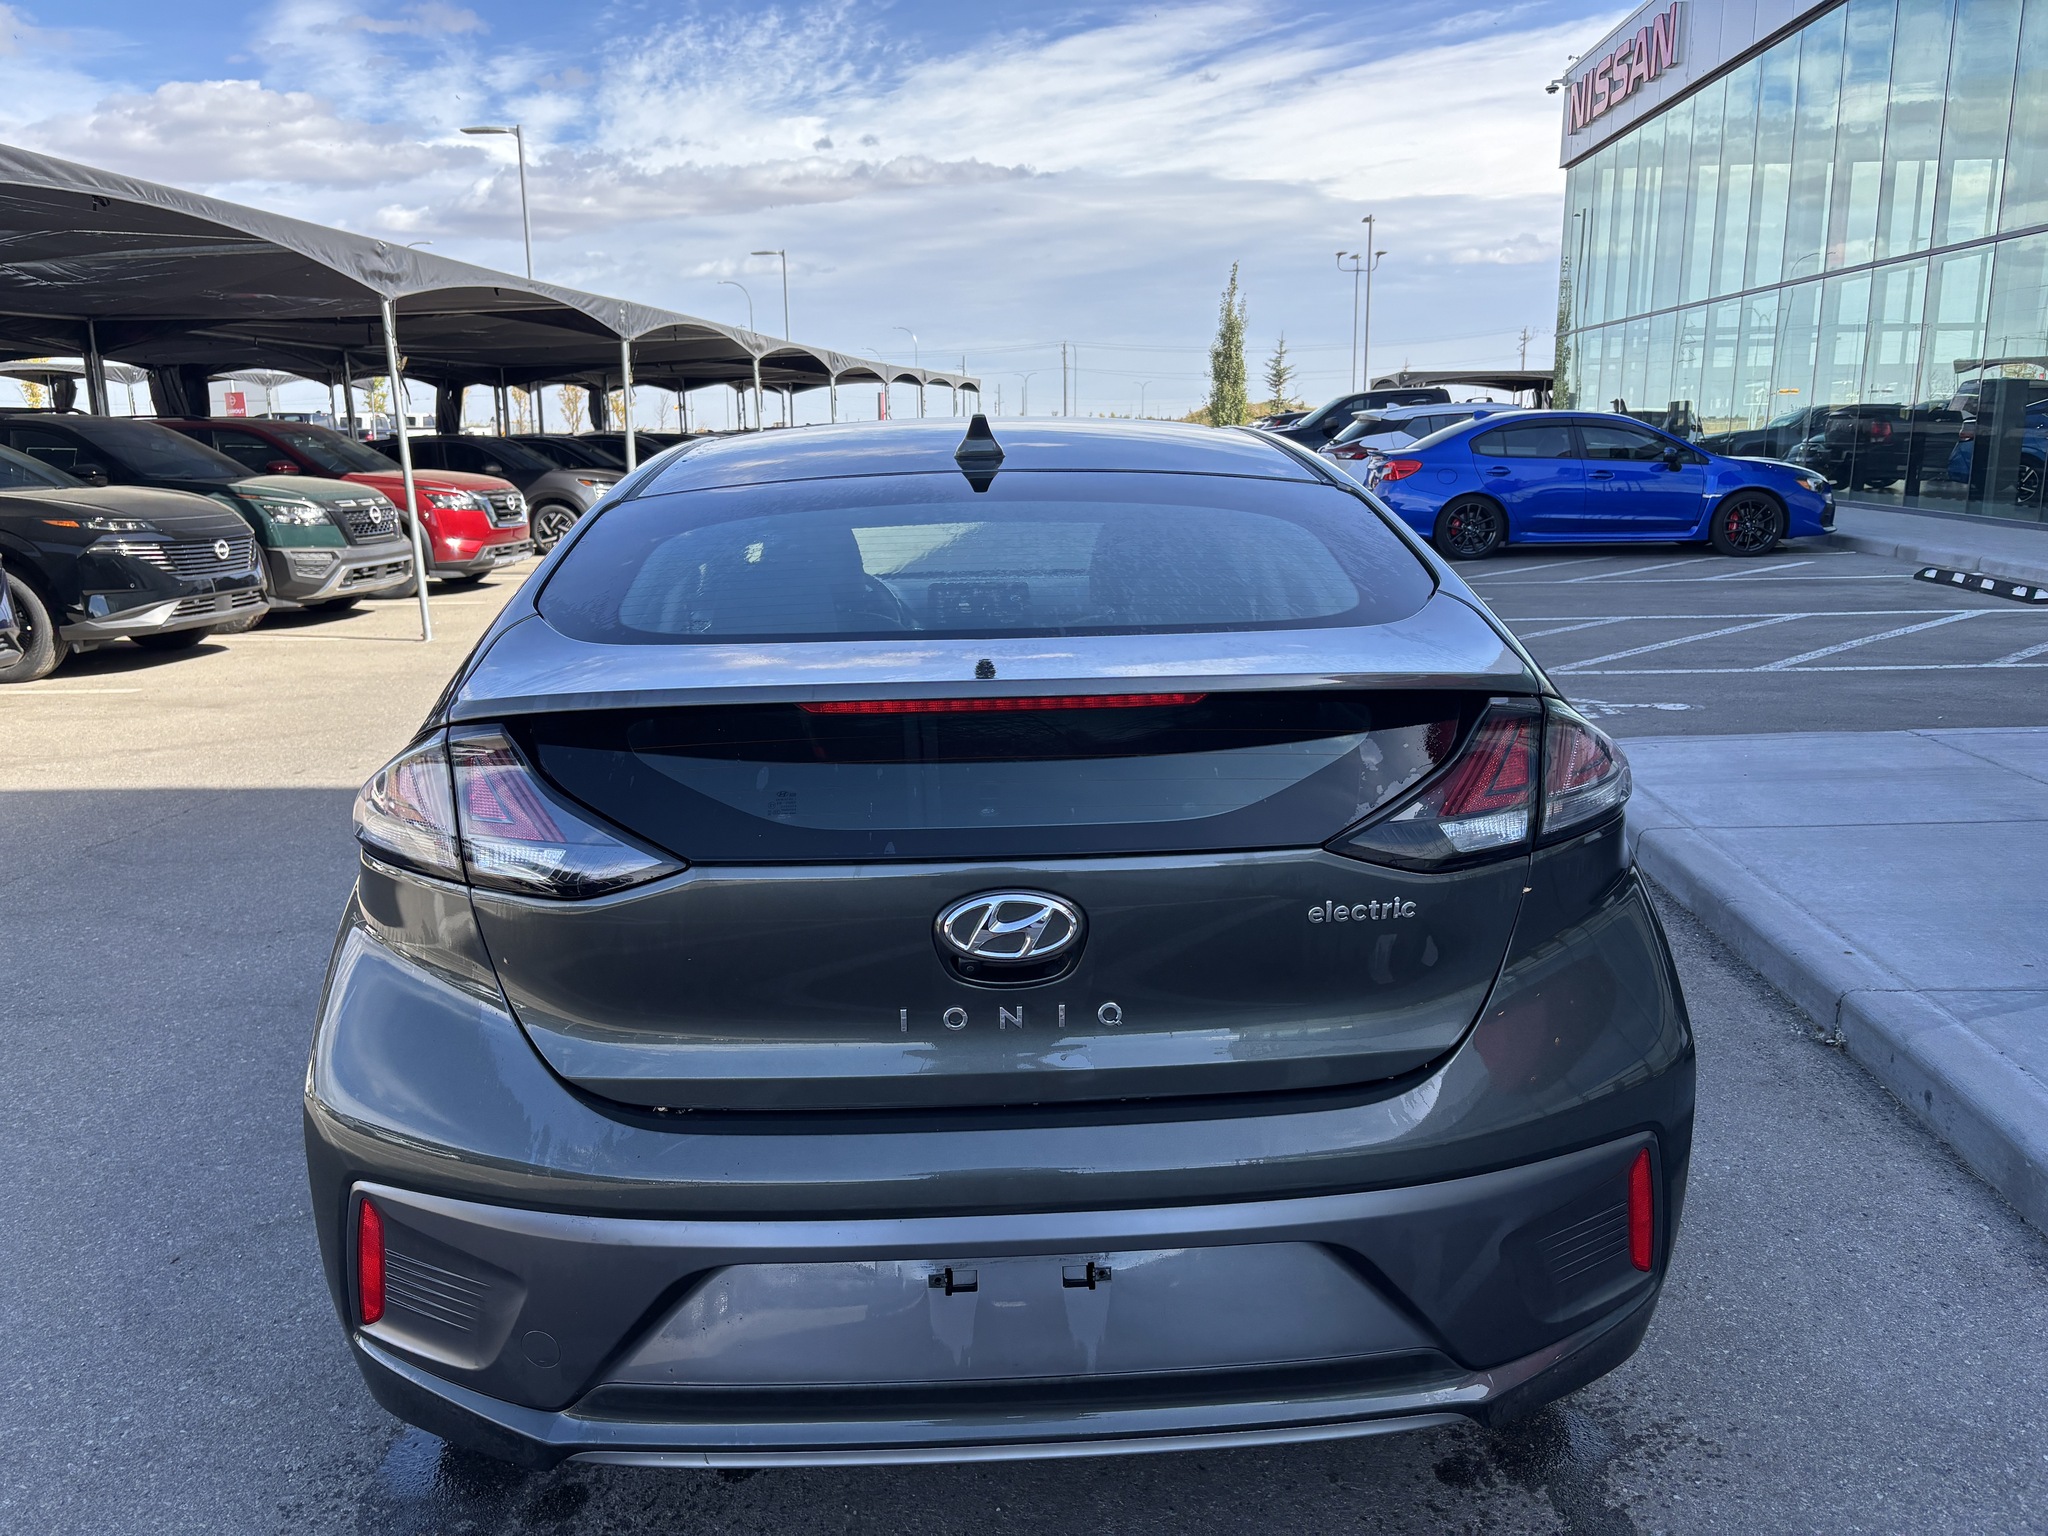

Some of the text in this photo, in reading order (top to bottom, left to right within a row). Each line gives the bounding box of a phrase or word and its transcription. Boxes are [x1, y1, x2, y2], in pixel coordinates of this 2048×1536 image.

[1568, 2, 1681, 135] NISSAN
[1308, 896, 1417, 924] electric
[900, 1001, 1123, 1032] IONIQ
